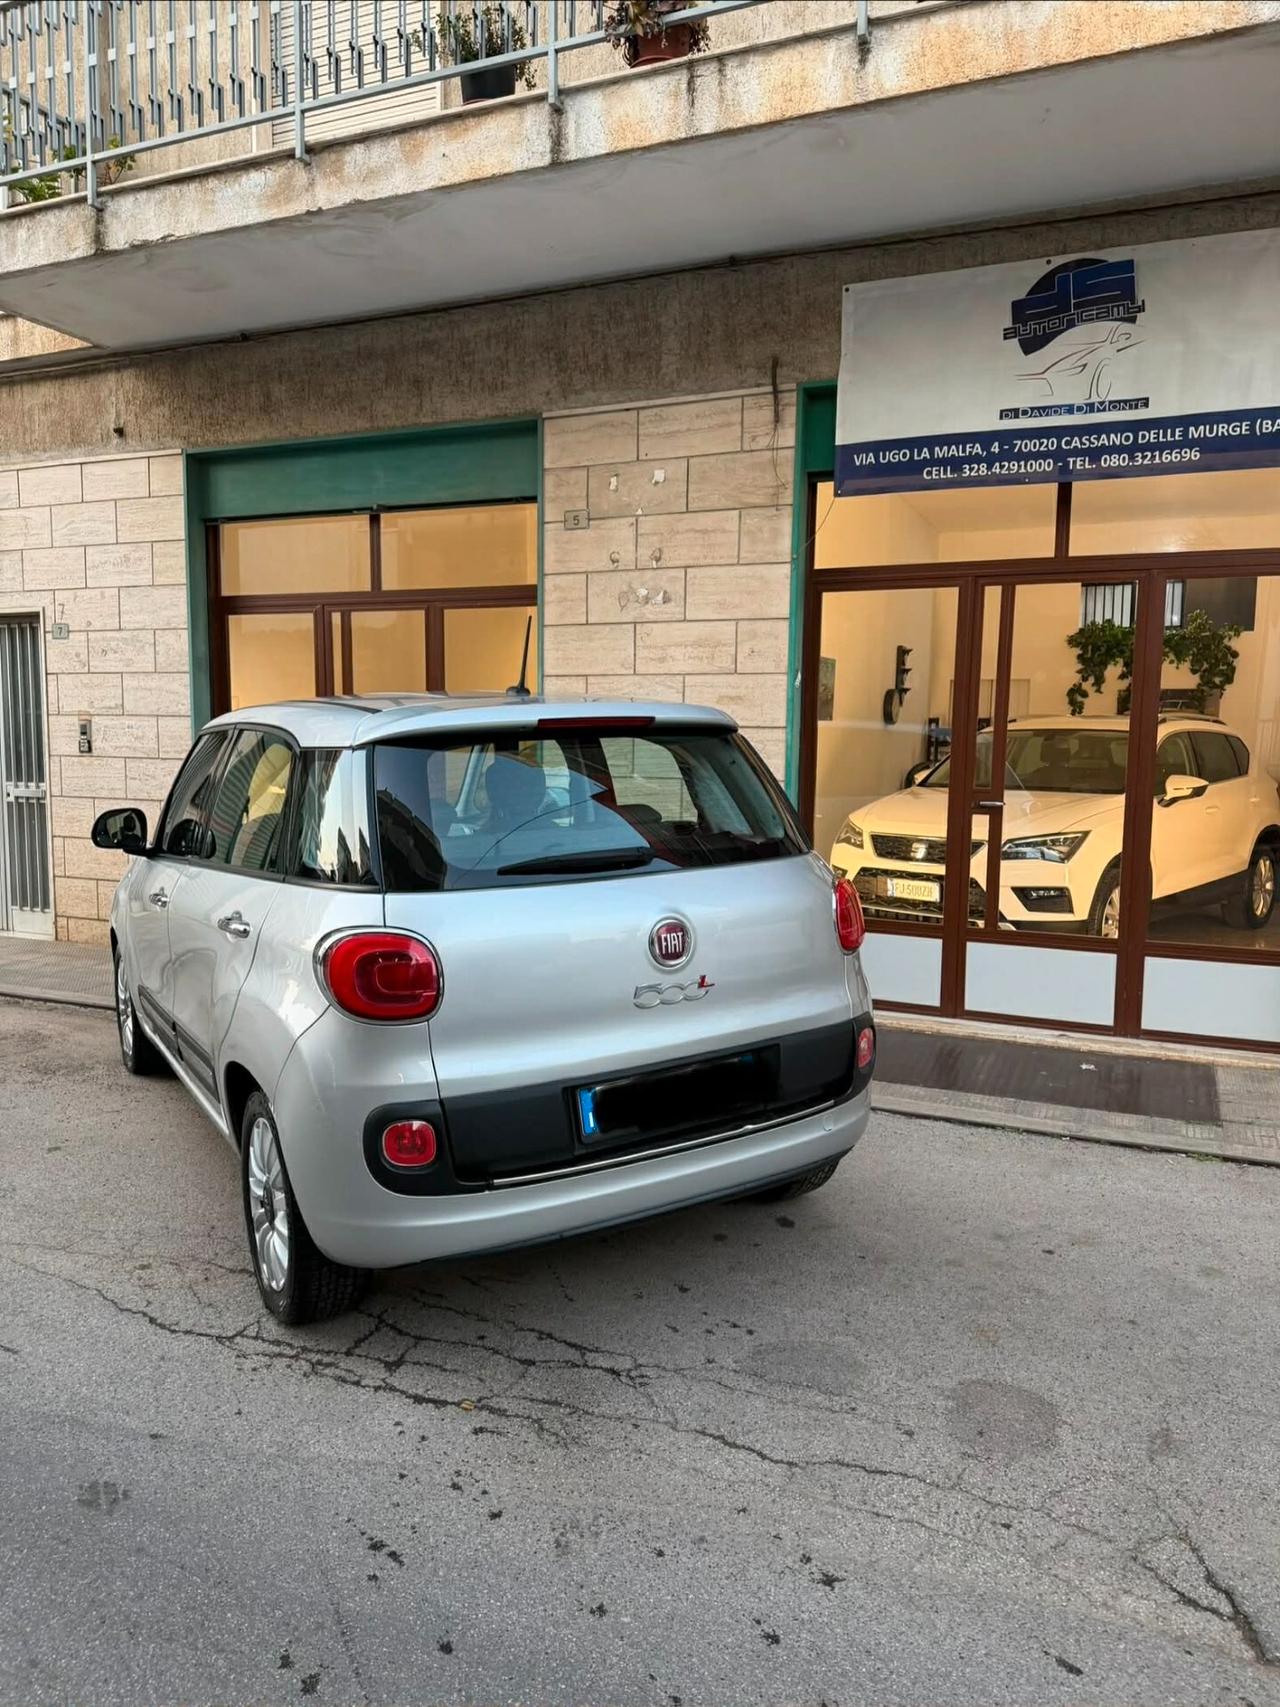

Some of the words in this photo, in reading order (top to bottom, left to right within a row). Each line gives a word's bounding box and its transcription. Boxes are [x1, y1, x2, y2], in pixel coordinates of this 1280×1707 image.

[853, 453, 876, 466] VIA
[879, 449, 910, 464] UGO
[914, 447, 931, 461] LA
[934, 442, 987, 459] MALFA,
[990, 441, 1000, 455] 4
[1013, 437, 1057, 453] 70020
[1061, 432, 1134, 450] CASSANO
[1138, 427, 1184, 444] DELLE
[1188, 421, 1251, 439] MURGE
[923, 465, 957, 480] CELL.
[962, 458, 1054, 477] 328.4291000
[1067, 456, 1096, 470] TEL.
[1101, 447, 1201, 468] 080.3216696
[573, 515, 580, 526] 5
[57, 626, 63, 636] 7
[660, 932, 684, 955] FIAT
[633, 974, 715, 1010] 500L
